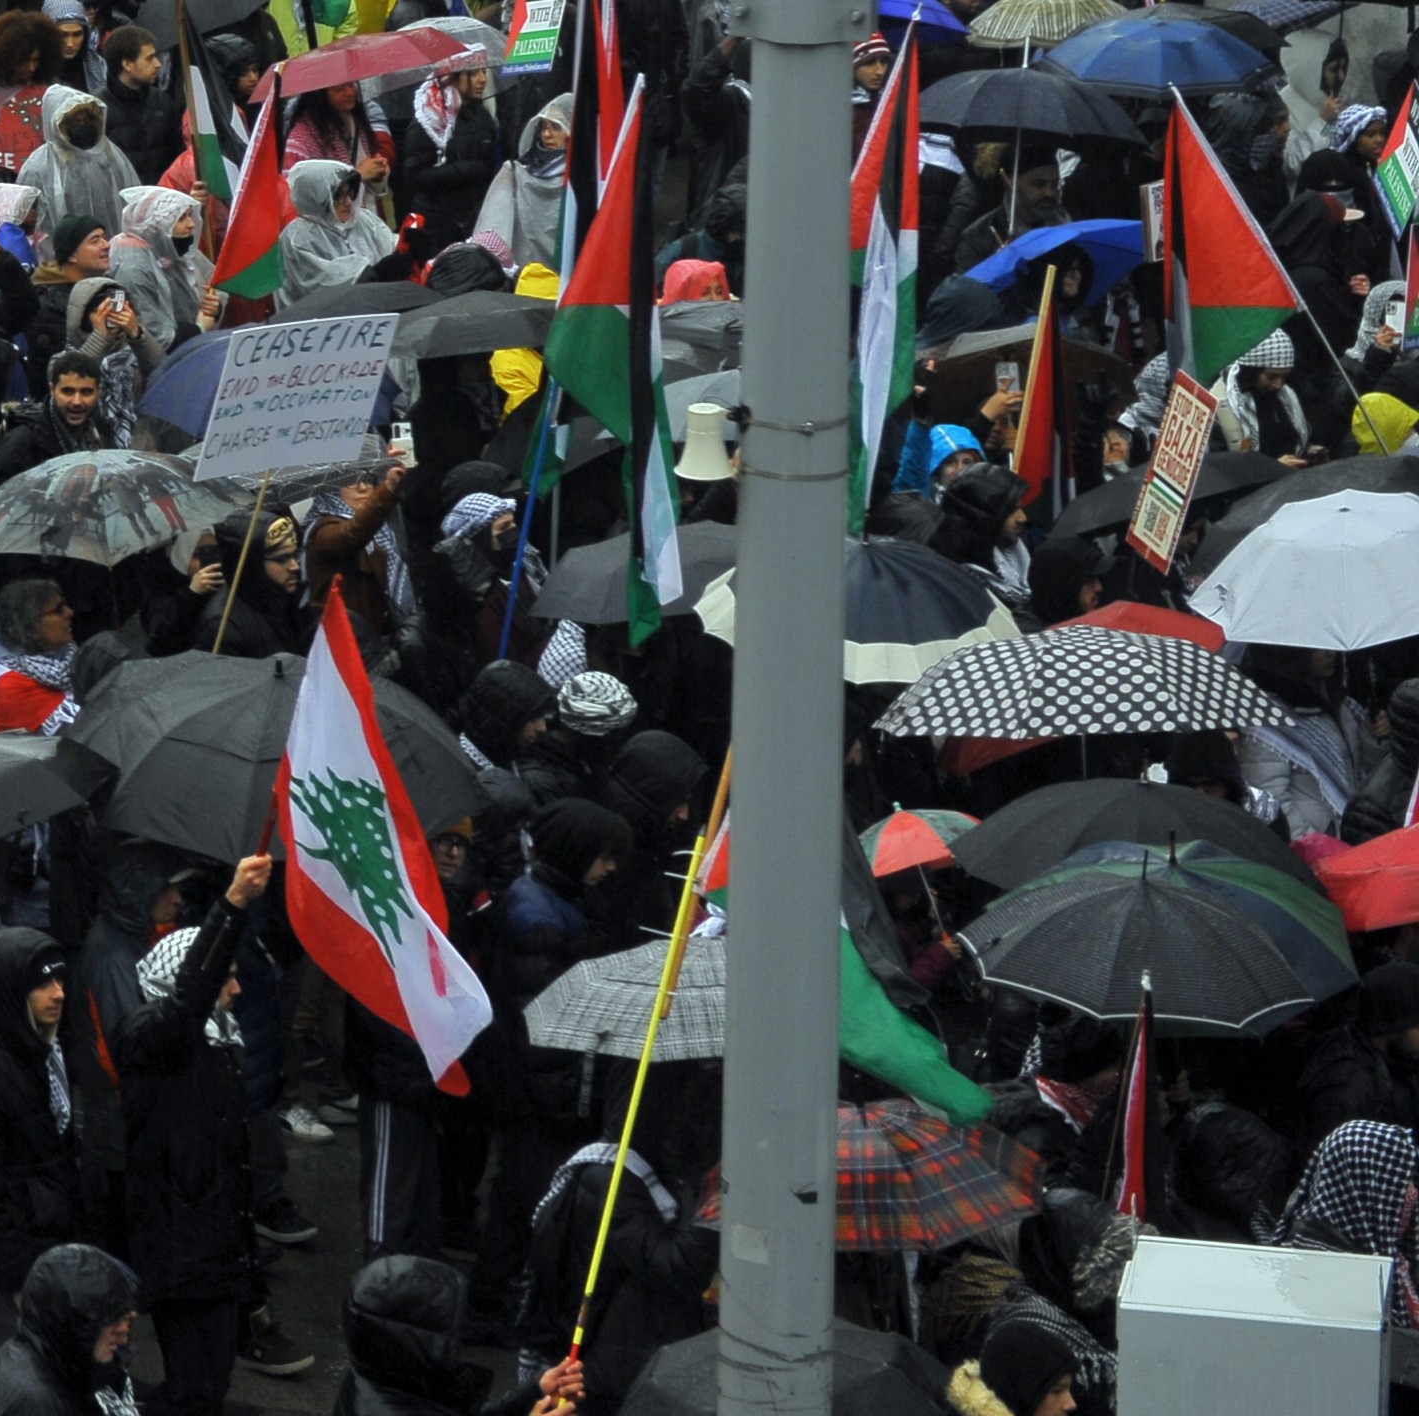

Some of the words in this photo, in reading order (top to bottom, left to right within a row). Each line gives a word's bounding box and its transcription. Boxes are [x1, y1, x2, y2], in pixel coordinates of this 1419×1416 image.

[512, 37, 556, 57] PALESTINE
[219, 375, 259, 399] END
[287, 359, 384, 389] BLOCKADE
[1164, 410, 1201, 466] GAZA
[1154, 445, 1191, 492] GENOCIDE
